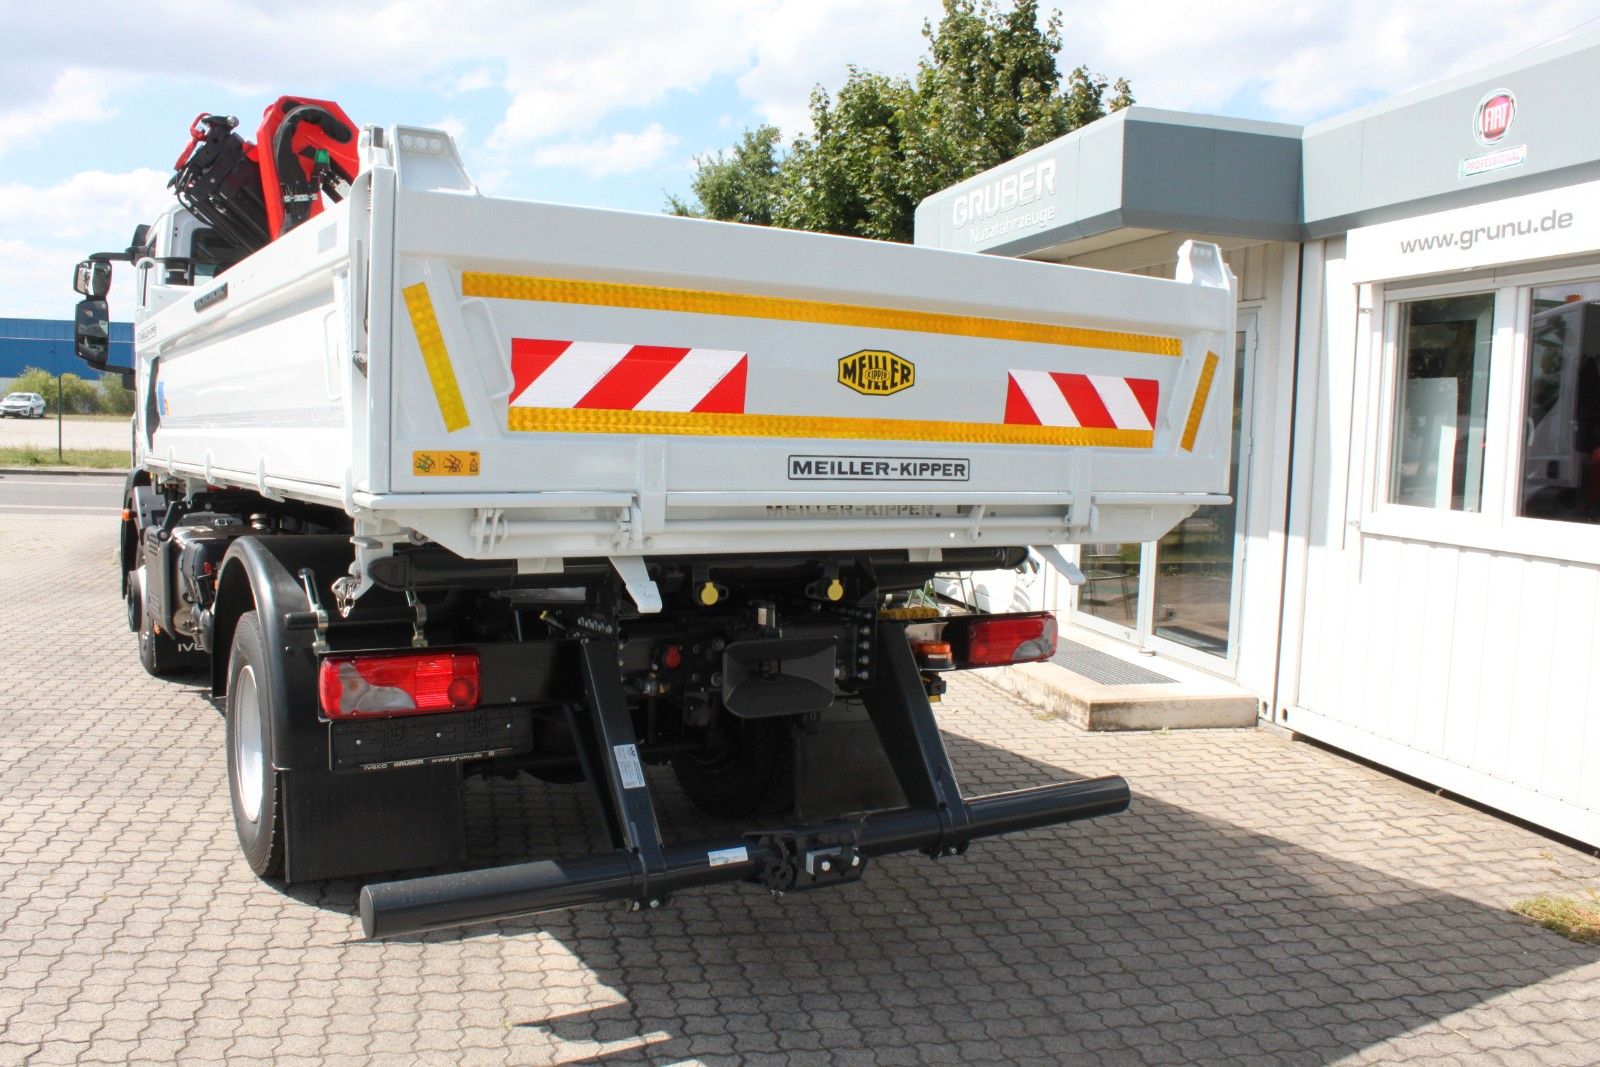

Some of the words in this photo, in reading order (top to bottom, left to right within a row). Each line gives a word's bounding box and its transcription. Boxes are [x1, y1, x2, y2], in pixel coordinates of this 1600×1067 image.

[1484, 102, 1509, 133] FIAT
[1465, 151, 1520, 170] PROFESSIONAL
[953, 158, 1056, 230] GRUBER
[969, 205, 1056, 243] Nutzfahrzeuge
[1400, 209, 1573, 253] www.grunu.de
[842, 355, 911, 391] MEILLER
[867, 368, 888, 381] KIPPER
[792, 460, 966, 476] MEILLER-KIPPER
